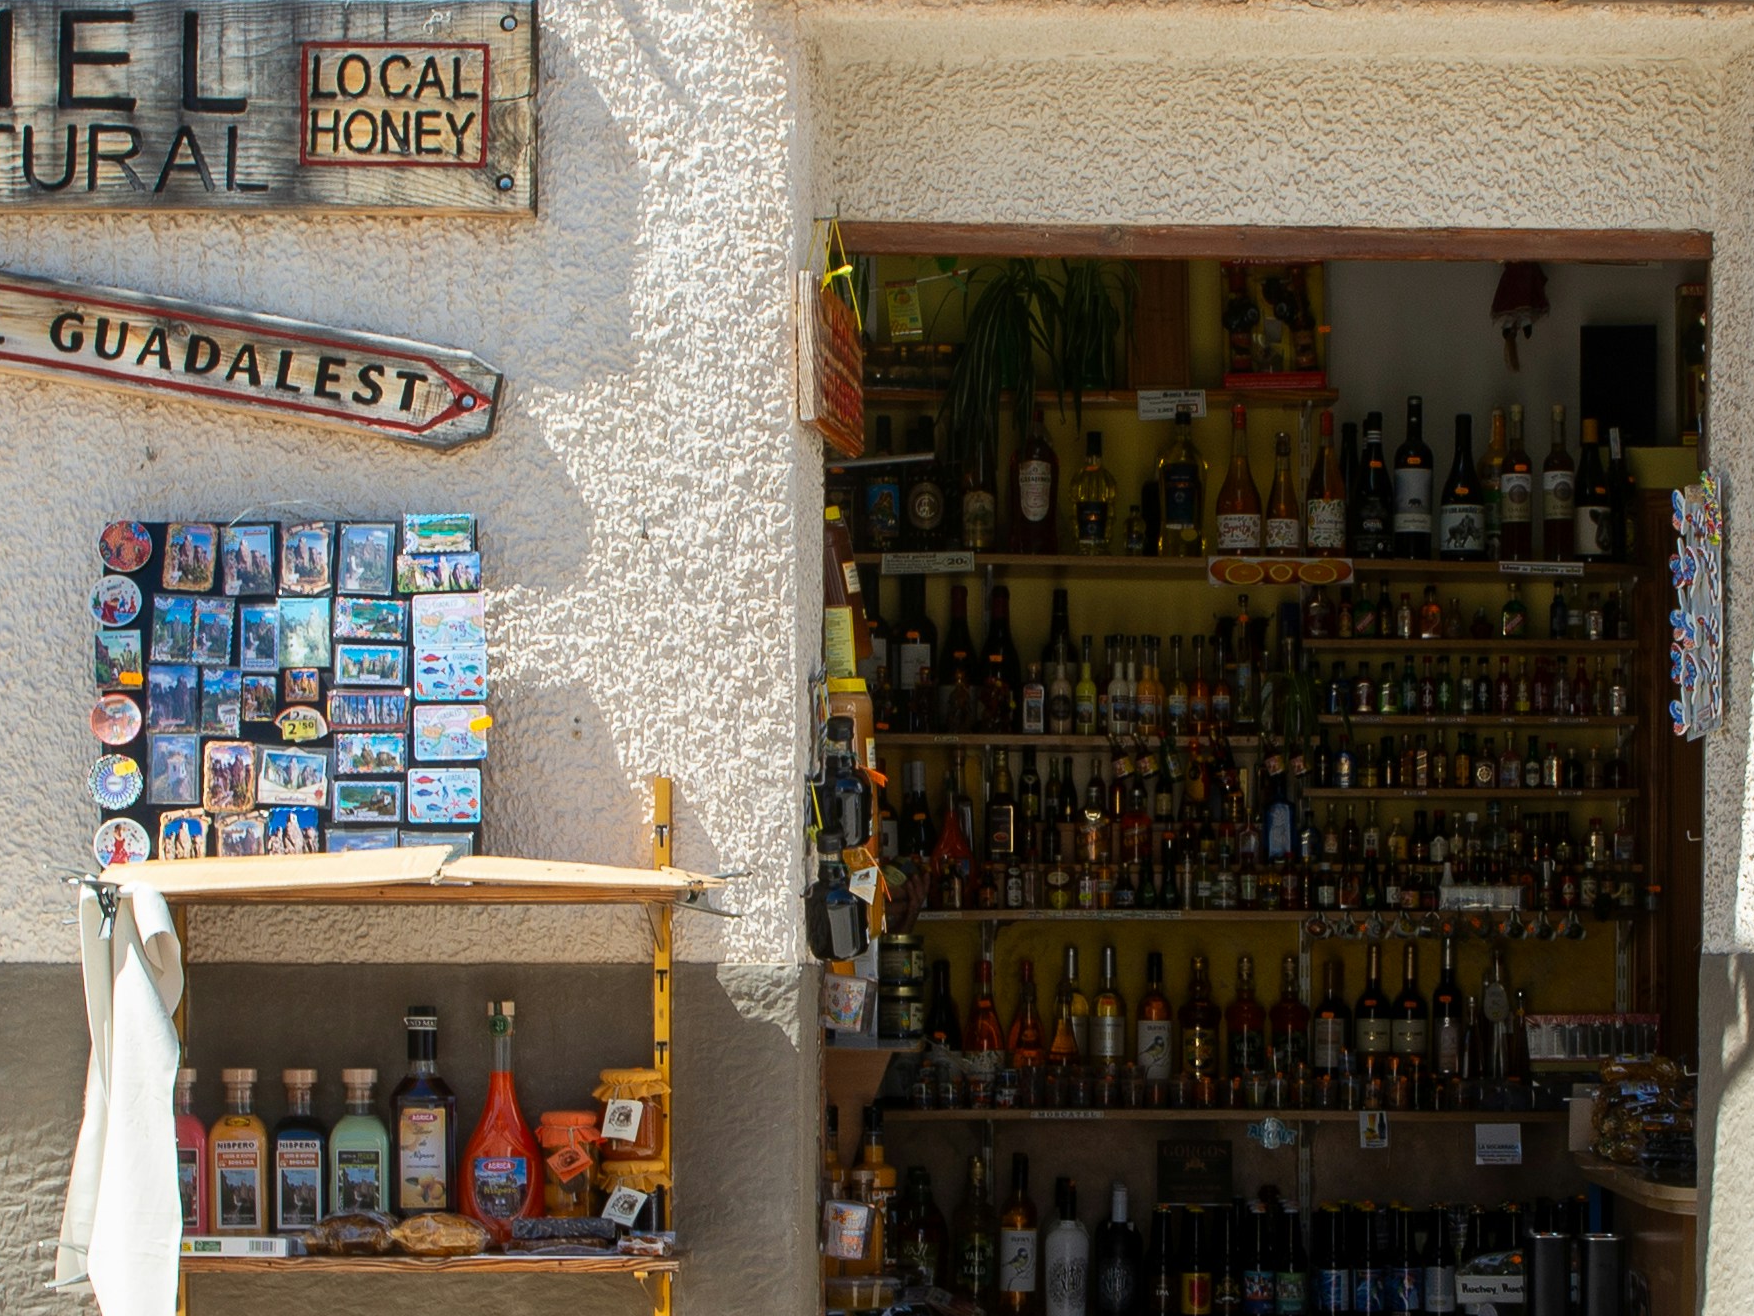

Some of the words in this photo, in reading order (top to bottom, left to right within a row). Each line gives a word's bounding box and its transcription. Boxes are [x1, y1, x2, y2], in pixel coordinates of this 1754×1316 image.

[310, 52, 480, 100] LOCAL
[308, 110, 477, 157] HONEY
[50, 310, 429, 413] GUADALEST
[1162, 1145, 1228, 1158] GORGOS
